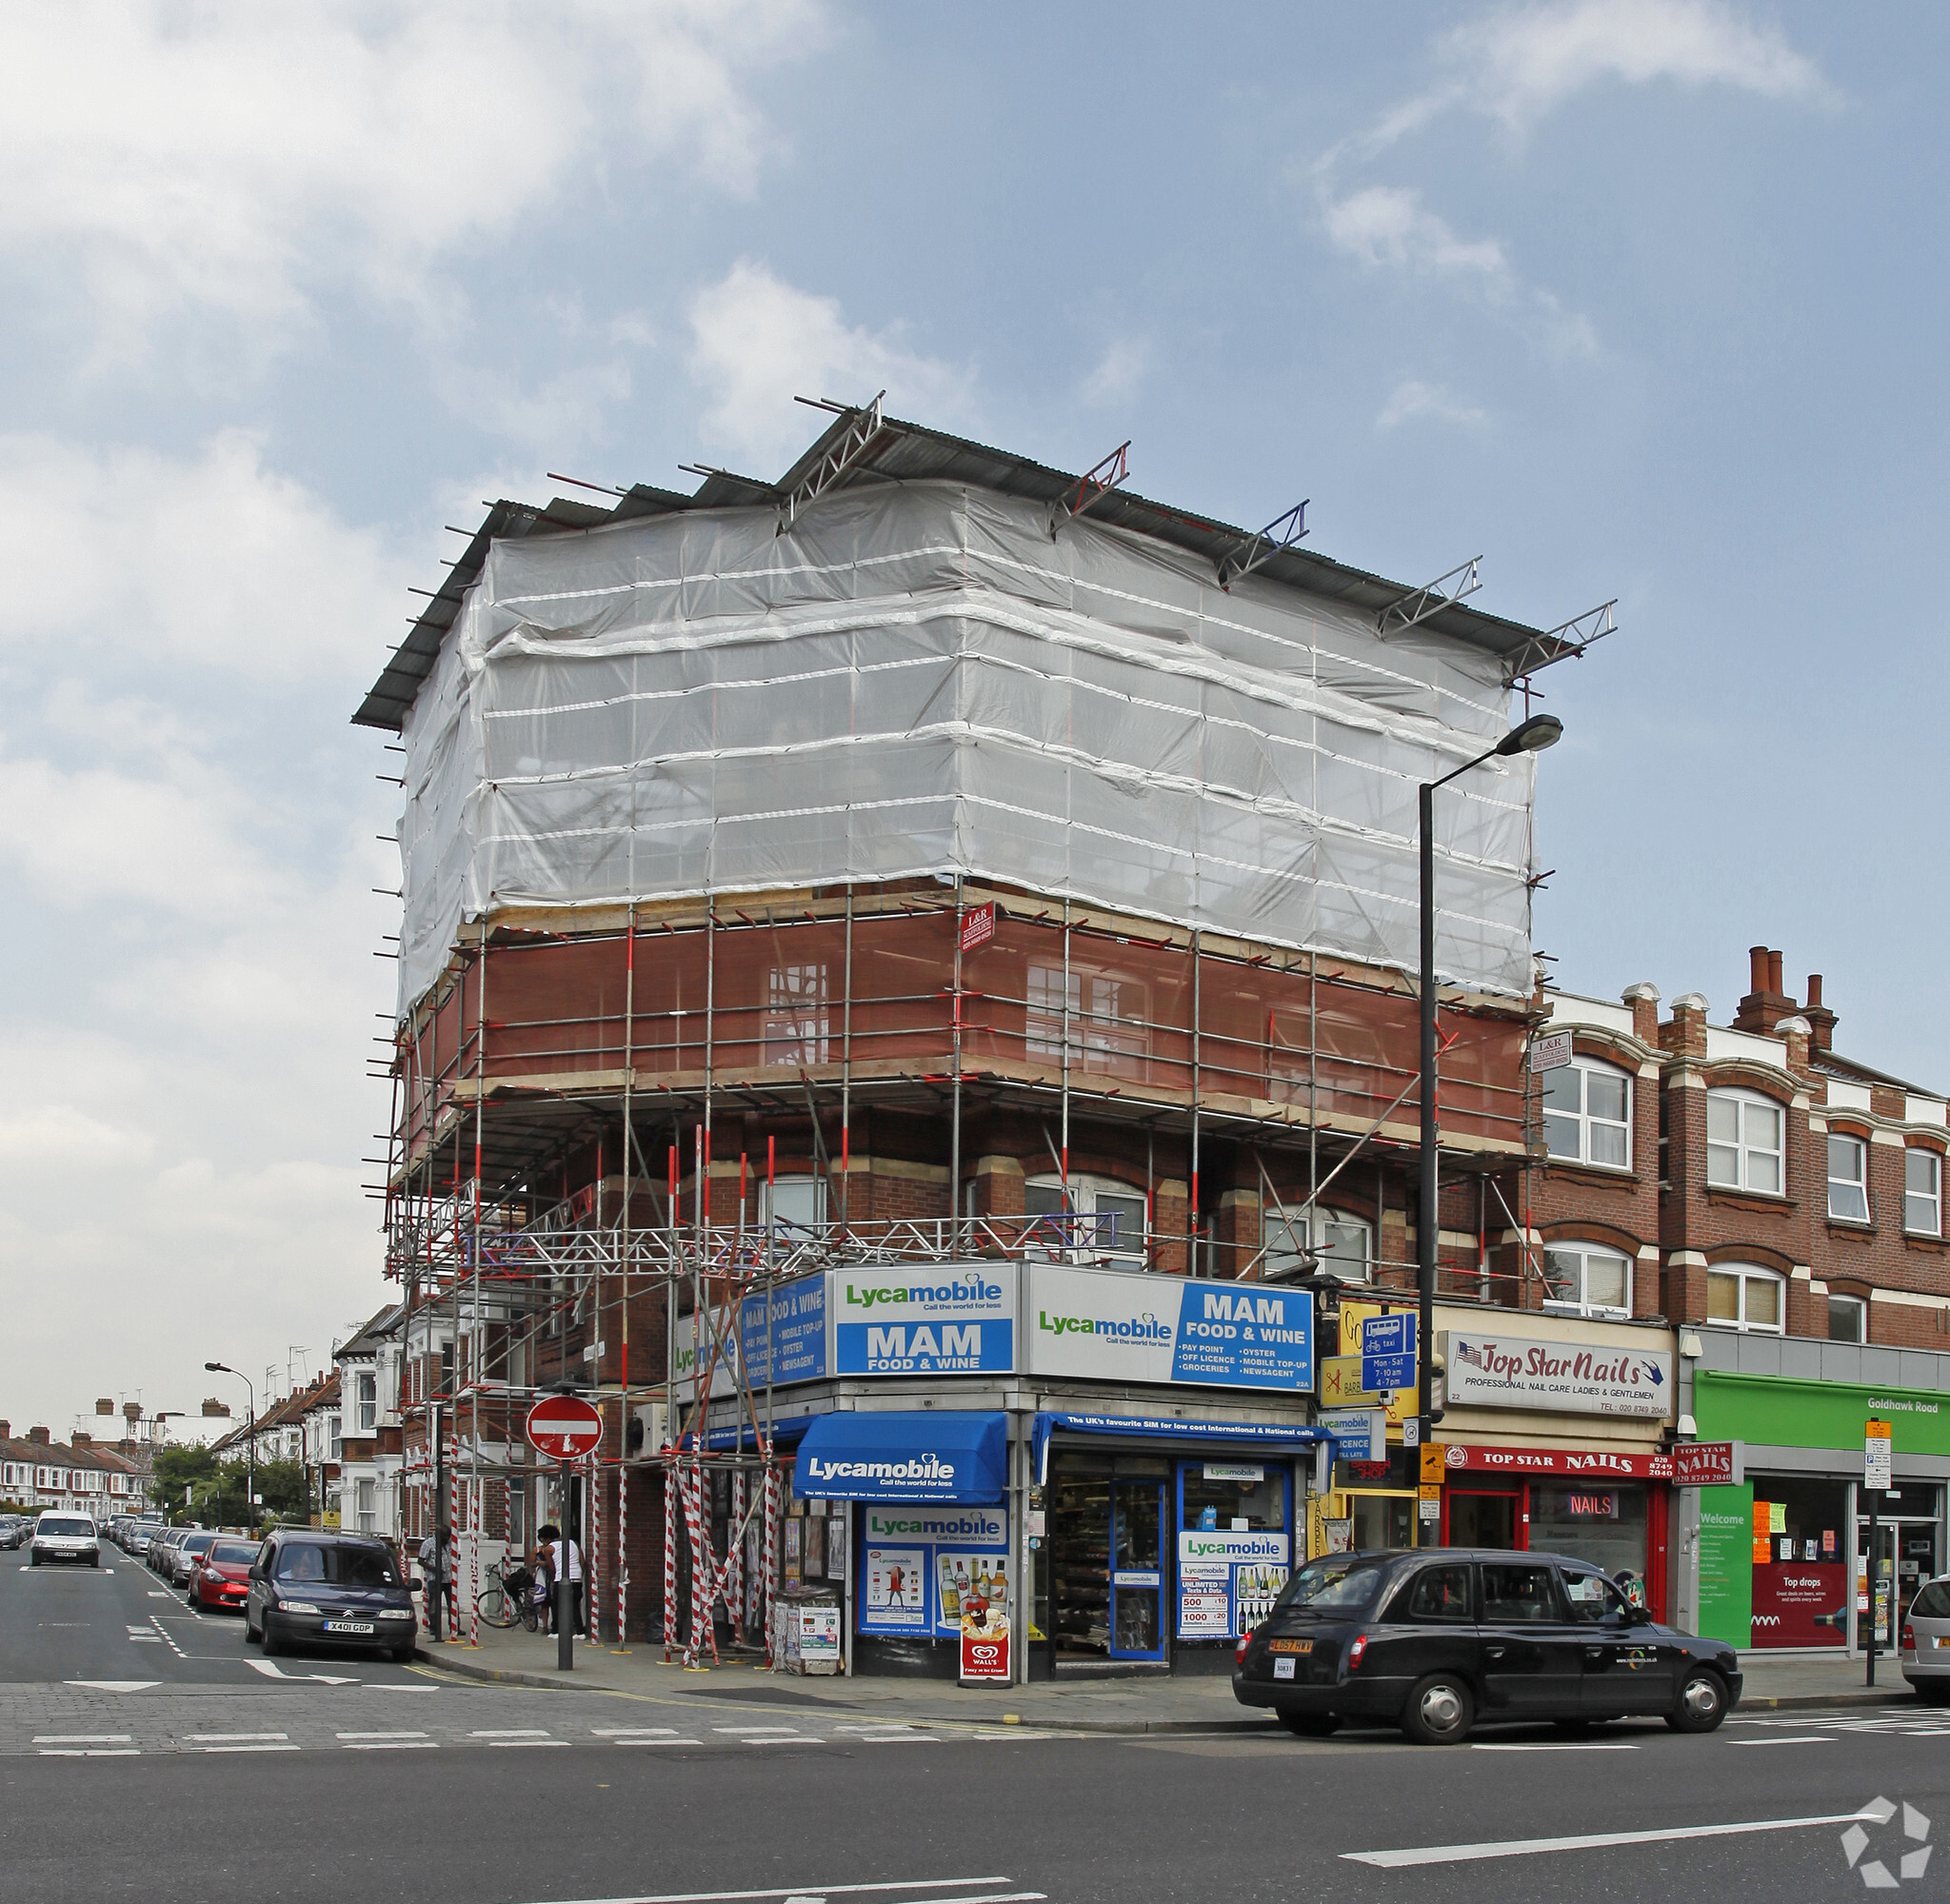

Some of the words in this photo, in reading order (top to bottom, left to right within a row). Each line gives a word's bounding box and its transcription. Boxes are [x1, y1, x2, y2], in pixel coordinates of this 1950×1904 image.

[968, 908, 987, 927] L&R
[1539, 1038, 1562, 1051] L&R
[846, 1274, 1002, 1308] Lycamobile
[746, 1308, 764, 1329] MAM
[766, 1301, 789, 1321] OOD
[790, 1297, 797, 1317] &
[799, 1289, 824, 1314] WINE
[1204, 1294, 1283, 1325] MAM
[803, 1319, 824, 1335] TOP-UP
[1040, 1311, 1172, 1340] Lycamobile
[1186, 1321, 1237, 1339] FOOD
[1243, 1327, 1255, 1340] &
[1262, 1329, 1305, 1344] WINE
[782, 1341, 803, 1356] OYSTER
[867, 1324, 982, 1359] MAM
[1183, 1343, 1197, 1352] PAY
[1200, 1344, 1224, 1353] POINT
[756, 1347, 777, 1362] LICECE
[1183, 1353, 1198, 1361] OFF
[1201, 1355, 1235, 1363] LICENCE
[1244, 1348, 1275, 1358] OYSTER
[868, 1358, 914, 1371] FOOD
[920, 1358, 931, 1371] &
[937, 1357, 980, 1369] WINE
[1183, 1363, 1229, 1373] GROCERIES
[1244, 1358, 1274, 1367] MOBILE
[1277, 1359, 1307, 1369] TOP-UP
[1373, 1359, 1387, 1367] Mon
[1392, 1358, 1403, 1366] Sat
[1482, 1343, 1522, 1380] Top
[1525, 1347, 1572, 1378] Star
[1573, 1352, 1640, 1385] Nails
[1244, 1367, 1294, 1378] NEWSAGENT
[1465, 1377, 1525, 1390] PROFESSIONAL
[1528, 1381, 1546, 1393] NAIL
[1548, 1383, 1570, 1394] CARE
[1573, 1385, 1600, 1396] LADIES
[1602, 1387, 1607, 1396] &
[1610, 1388, 1654, 1400] GENTLEMEN
[1619, 1403, 1632, 1412] 020
[1634, 1405, 1649, 1414] 8749
[1651, 1406, 1667, 1415] 2040
[1867, 1397, 1914, 1412] Goldhawk
[1915, 1400, 1939, 1414] Road
[1085, 1417, 1104, 1425] UK's
[1105, 1418, 1142, 1427] favourite
[1207, 1424, 1256, 1434] International
[1264, 1427, 1295, 1436] National
[1320, 1415, 1368, 1428] Lycamobile
[1340, 1438, 1369, 1448] ICENCE
[809, 1453, 954, 1481] Lycamobile
[1483, 1452, 1514, 1464] TOP
[1516, 1455, 1554, 1466] STAR
[1566, 1454, 1633, 1473] NAILS
[1677, 1454, 1730, 1475] NAILS
[1211, 1467, 1256, 1477] Lycamobile
[1571, 1496, 1611, 1514] NAILS
[871, 1512, 1000, 1536] Lycamobile
[1700, 1513, 1744, 1524] Welcome
[1188, 1537, 1280, 1557] Lycamobile
[1184, 1564, 1225, 1575] Lycamobile
[1783, 1577, 1798, 1589] Top
[1800, 1577, 1821, 1589] drops
[331, 1622, 351, 1632] X401
[353, 1623, 370, 1632] GDP
